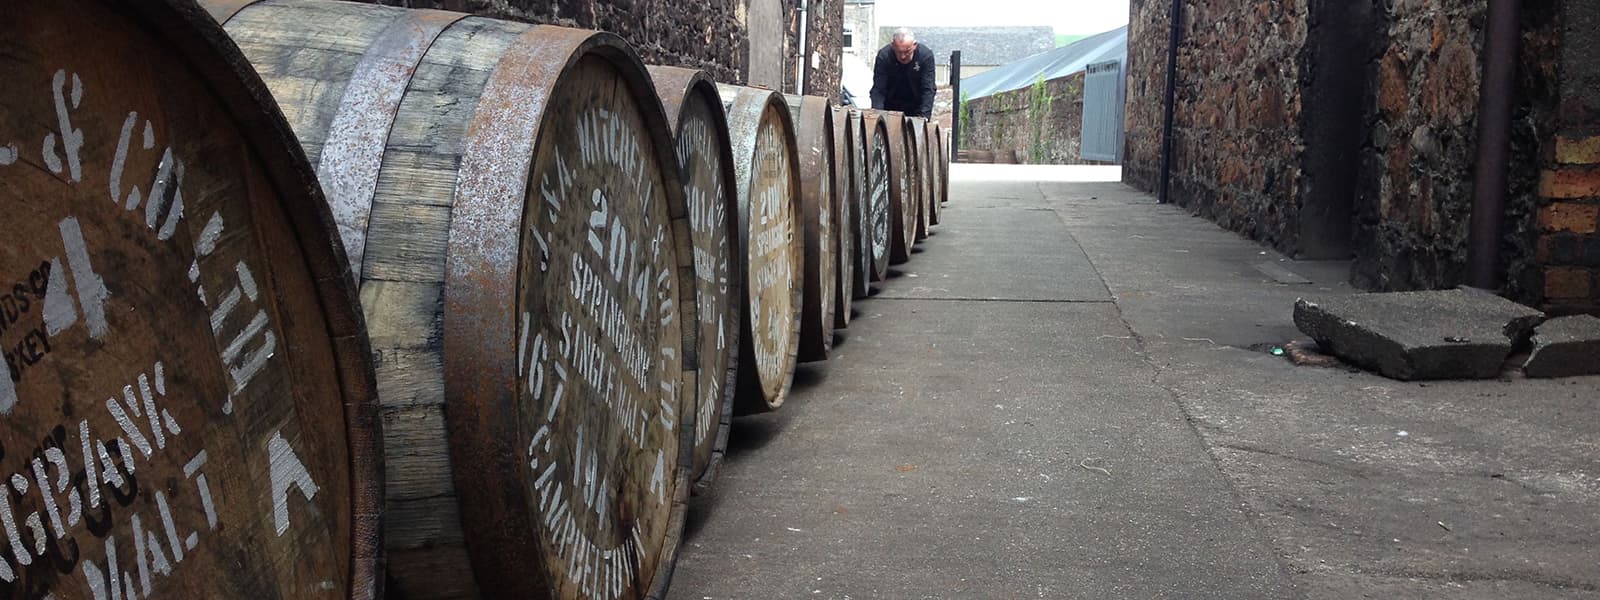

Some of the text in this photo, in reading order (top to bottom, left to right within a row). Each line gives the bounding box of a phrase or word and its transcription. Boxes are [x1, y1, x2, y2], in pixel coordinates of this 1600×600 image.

[570, 251, 651, 393] SPRINGBANK
[576, 107, 653, 228] MITCHELL
[660, 346, 677, 432] LTD
[587, 187, 650, 322] 2014
[518, 311, 568, 423] 167
[559, 310, 649, 450] SINGLE MALT
[717, 312, 726, 350] A
[83, 449, 219, 600] MALT
[267, 430, 321, 538] A
[529, 423, 646, 600] CAMPBELTOWN
[650, 447, 666, 506] A
